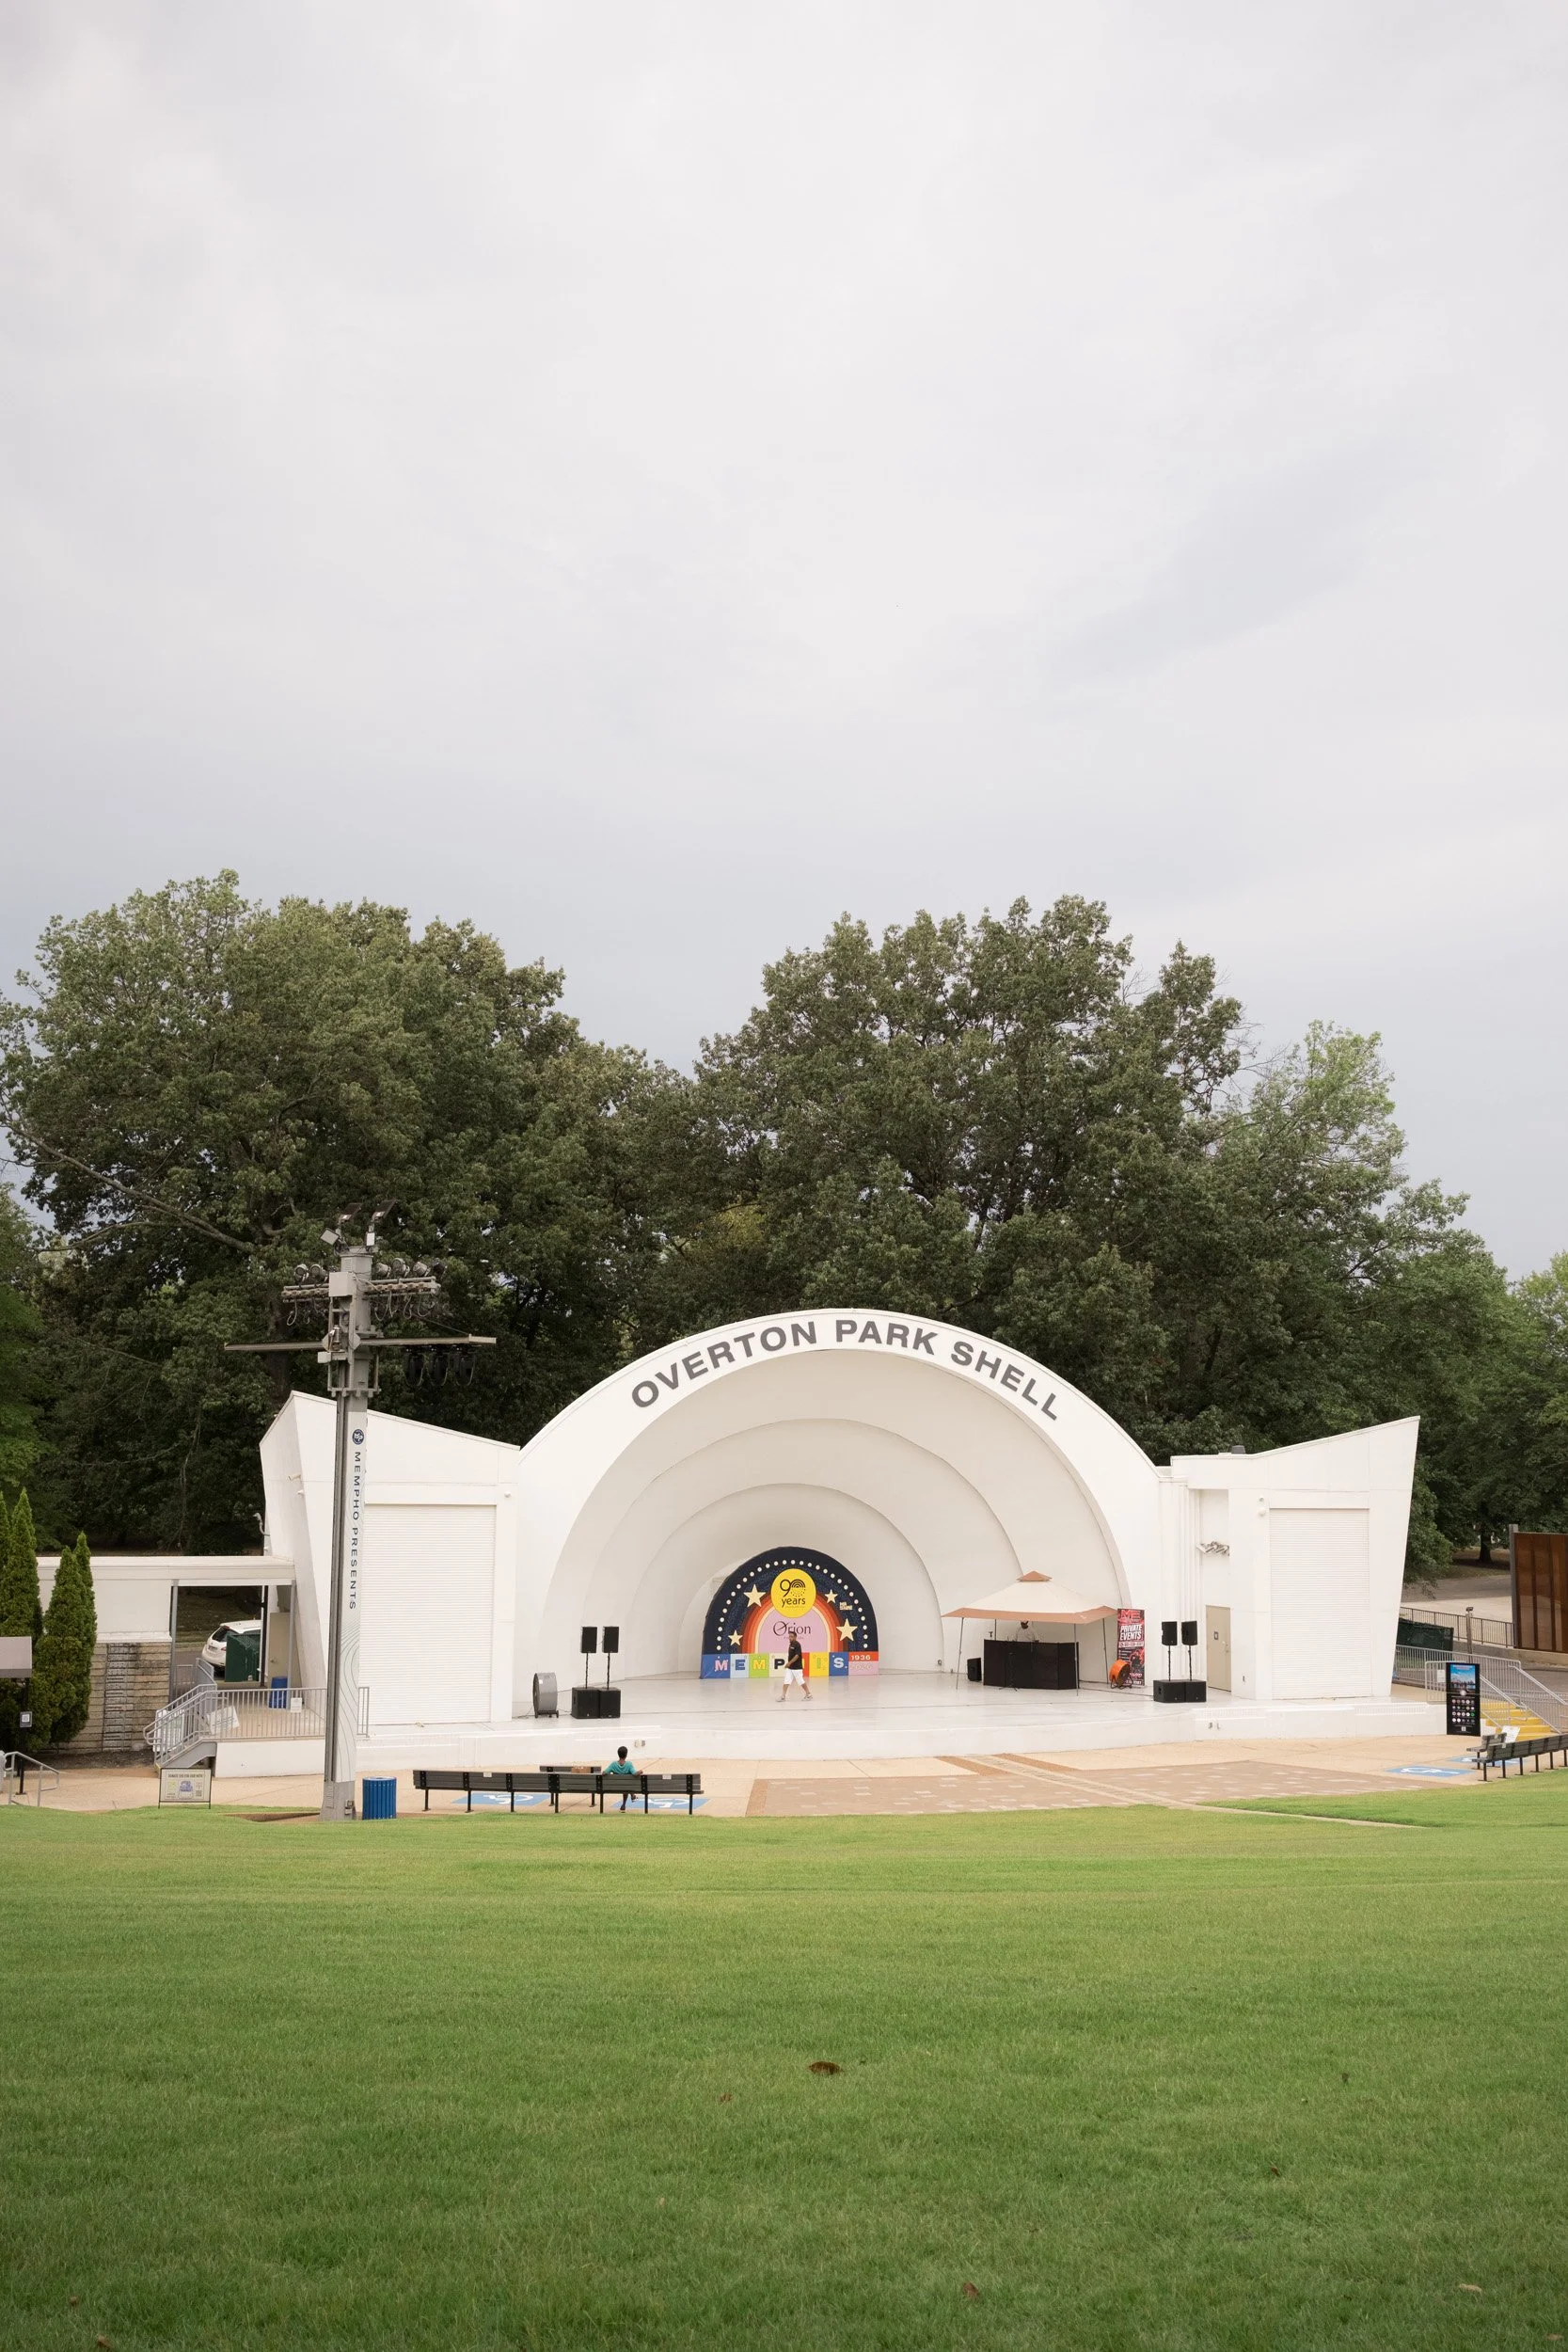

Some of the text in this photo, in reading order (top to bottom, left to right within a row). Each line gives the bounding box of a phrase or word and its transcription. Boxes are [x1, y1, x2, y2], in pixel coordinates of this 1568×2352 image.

[631, 1319, 1058, 1422] OVERTON PARK SHELL
[349, 1452, 361, 1610] MEMPHO PRESENTS
[779, 1579, 806, 1597] 90
[781, 1597, 806, 1608] years
[1119, 1631, 1142, 1641] EVENTS
[715, 1657, 845, 1671] MEMPIS
